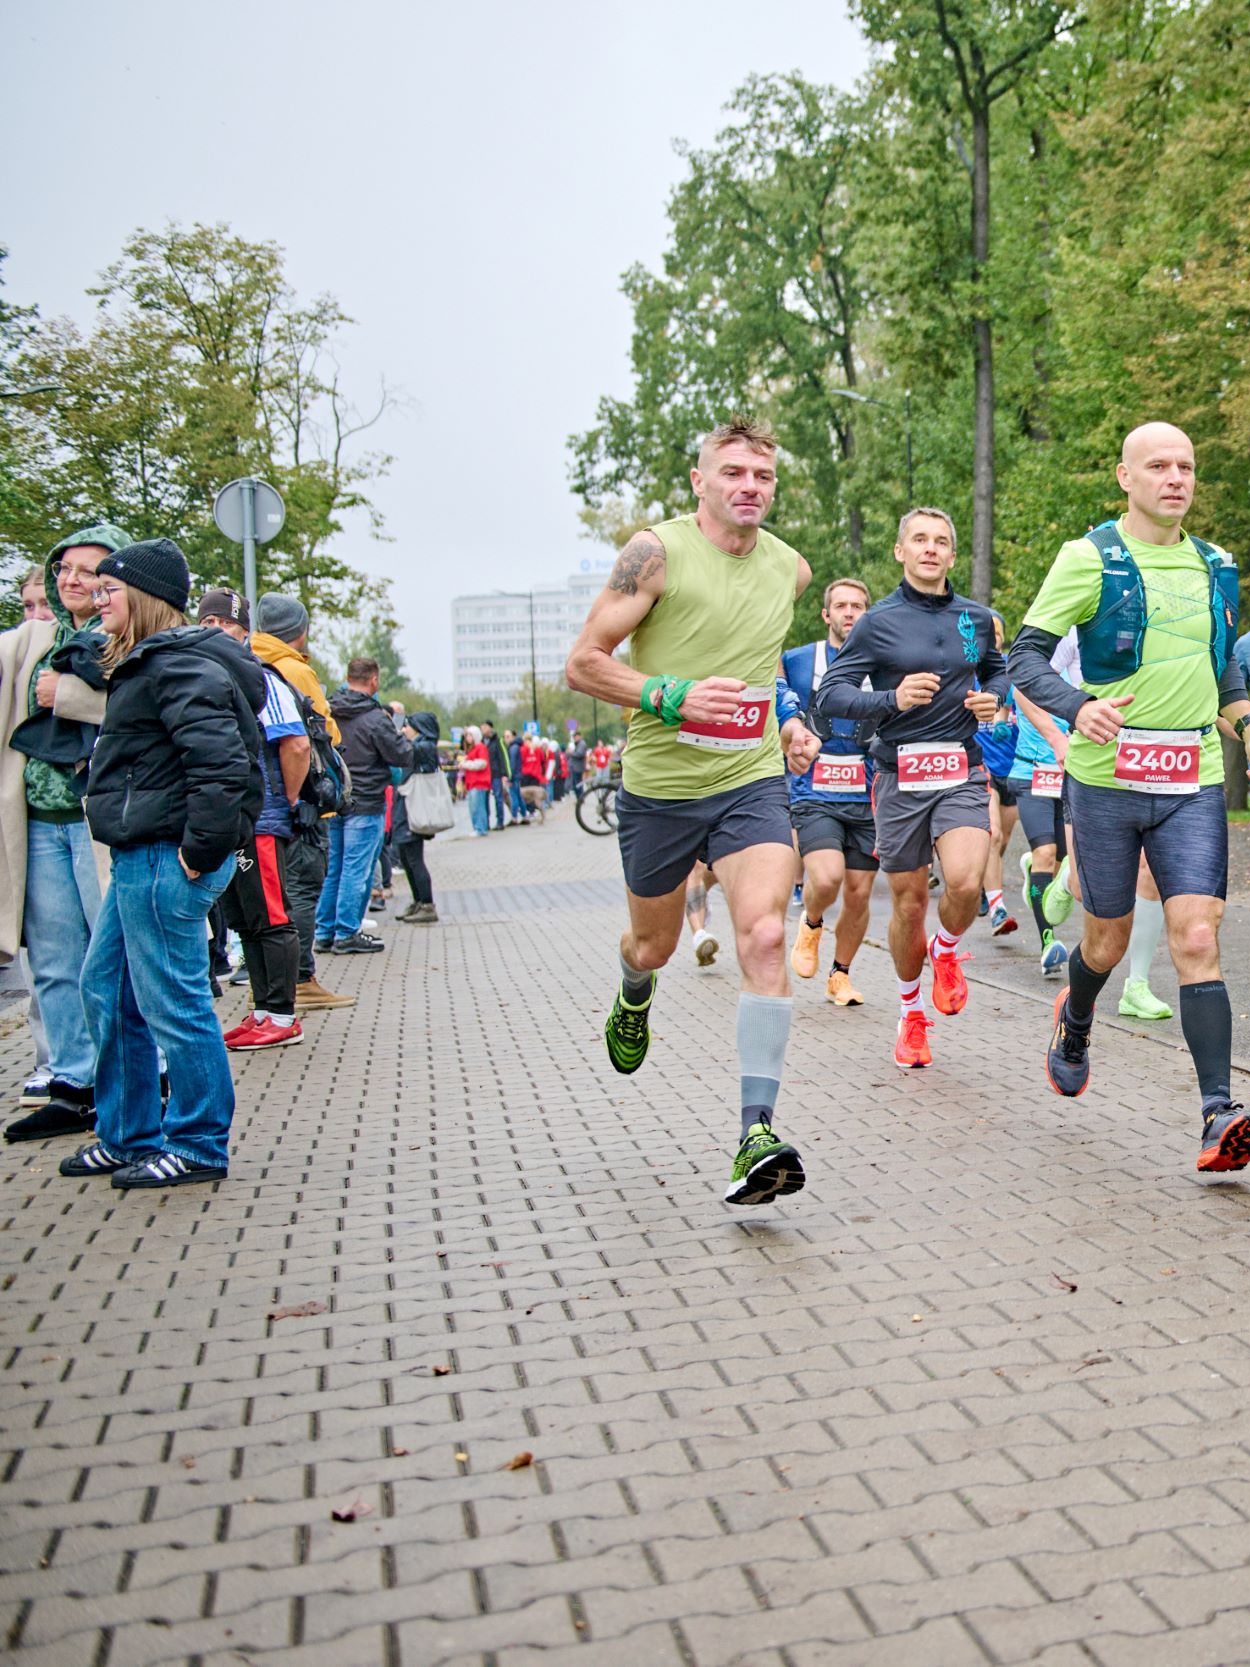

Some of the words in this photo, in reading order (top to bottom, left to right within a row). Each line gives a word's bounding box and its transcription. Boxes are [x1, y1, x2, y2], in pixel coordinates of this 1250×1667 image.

[731, 706, 760, 727] 49
[906, 755, 960, 774] 2498
[1125, 748, 1192, 771] 2400
[822, 765, 857, 780] 2501
